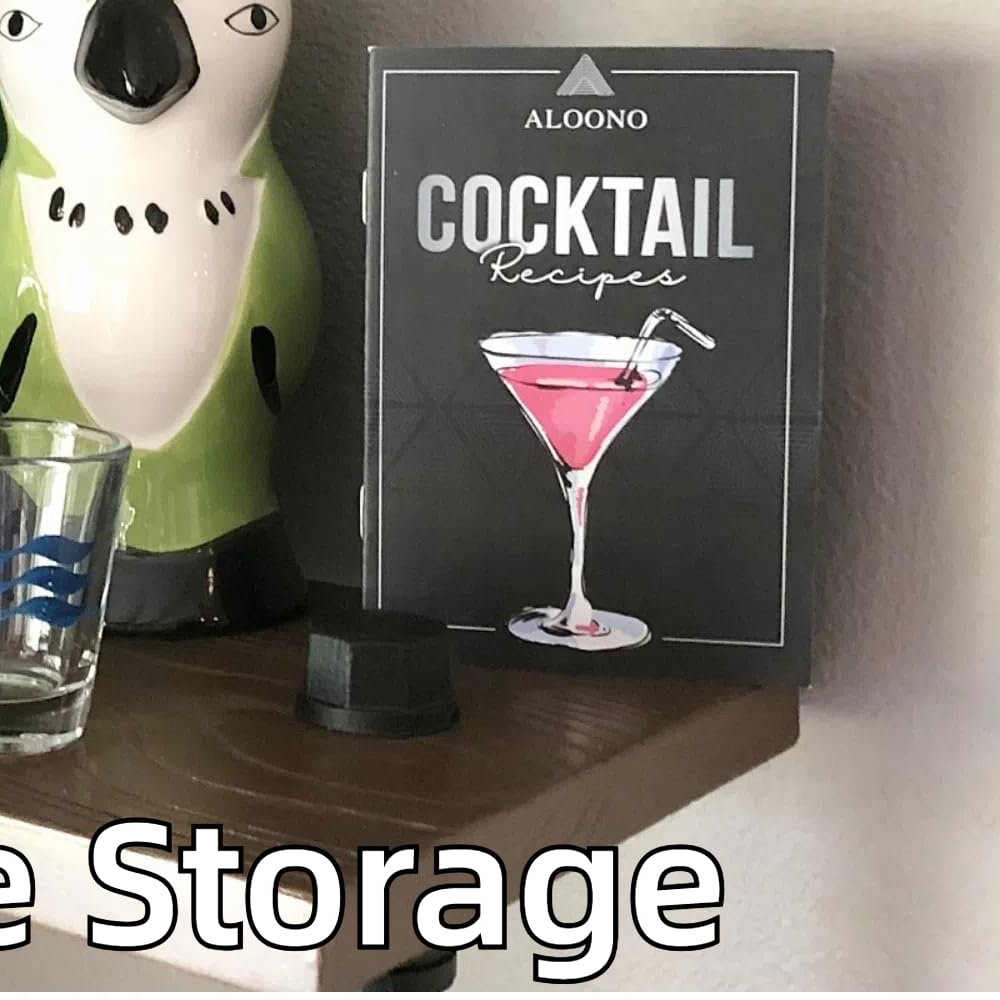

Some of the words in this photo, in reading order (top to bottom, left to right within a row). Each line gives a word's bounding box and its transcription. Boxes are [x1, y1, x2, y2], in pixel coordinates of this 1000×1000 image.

[524, 109, 648, 130] ALOONO
[417, 173, 754, 259] COCKTAIL
[479, 242, 687, 301] Recipes
